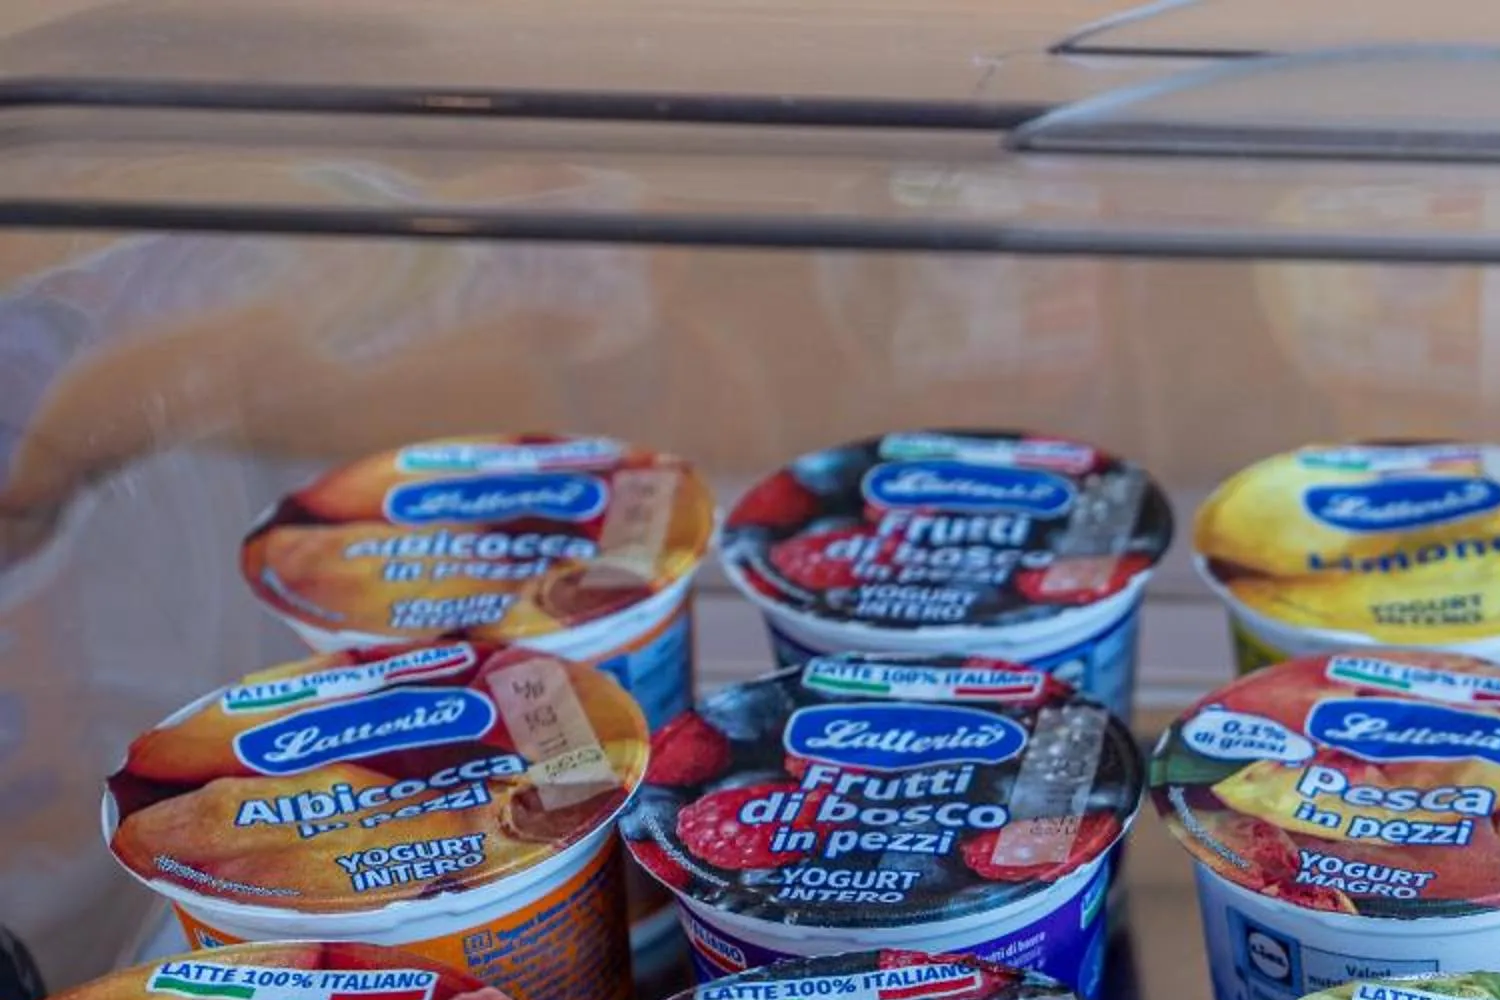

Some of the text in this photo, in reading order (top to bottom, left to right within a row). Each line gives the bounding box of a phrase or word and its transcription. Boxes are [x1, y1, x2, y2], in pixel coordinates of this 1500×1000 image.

[876, 512, 1032, 546] Frutti
[223, 680, 294, 703] LATTE
[264, 696, 467, 762] Latteria
[804, 719, 1007, 754] Latteria
[1193, 727, 1287, 756] di grassi
[235, 754, 528, 828] Albicocca
[800, 764, 978, 802] Frutti
[1296, 764, 1497, 820] Pesca
[361, 781, 493, 830] pezzi
[739, 790, 1010, 830] di bosco
[1294, 801, 1474, 847] in pezzi
[336, 832, 487, 874] YOGURT
[770, 825, 956, 859] in pezzi
[351, 852, 486, 892] INTERO
[781, 867, 920, 890] YOGURT
[1296, 870, 1418, 900] MAGRO
[1298, 850, 1436, 889] YOGURT
[779, 886, 907, 904] INTERO
[161, 962, 433, 991] LATTE 100% ITALIANO
[783, 977, 858, 998] 100%
[863, 962, 974, 991] ITALIANO
